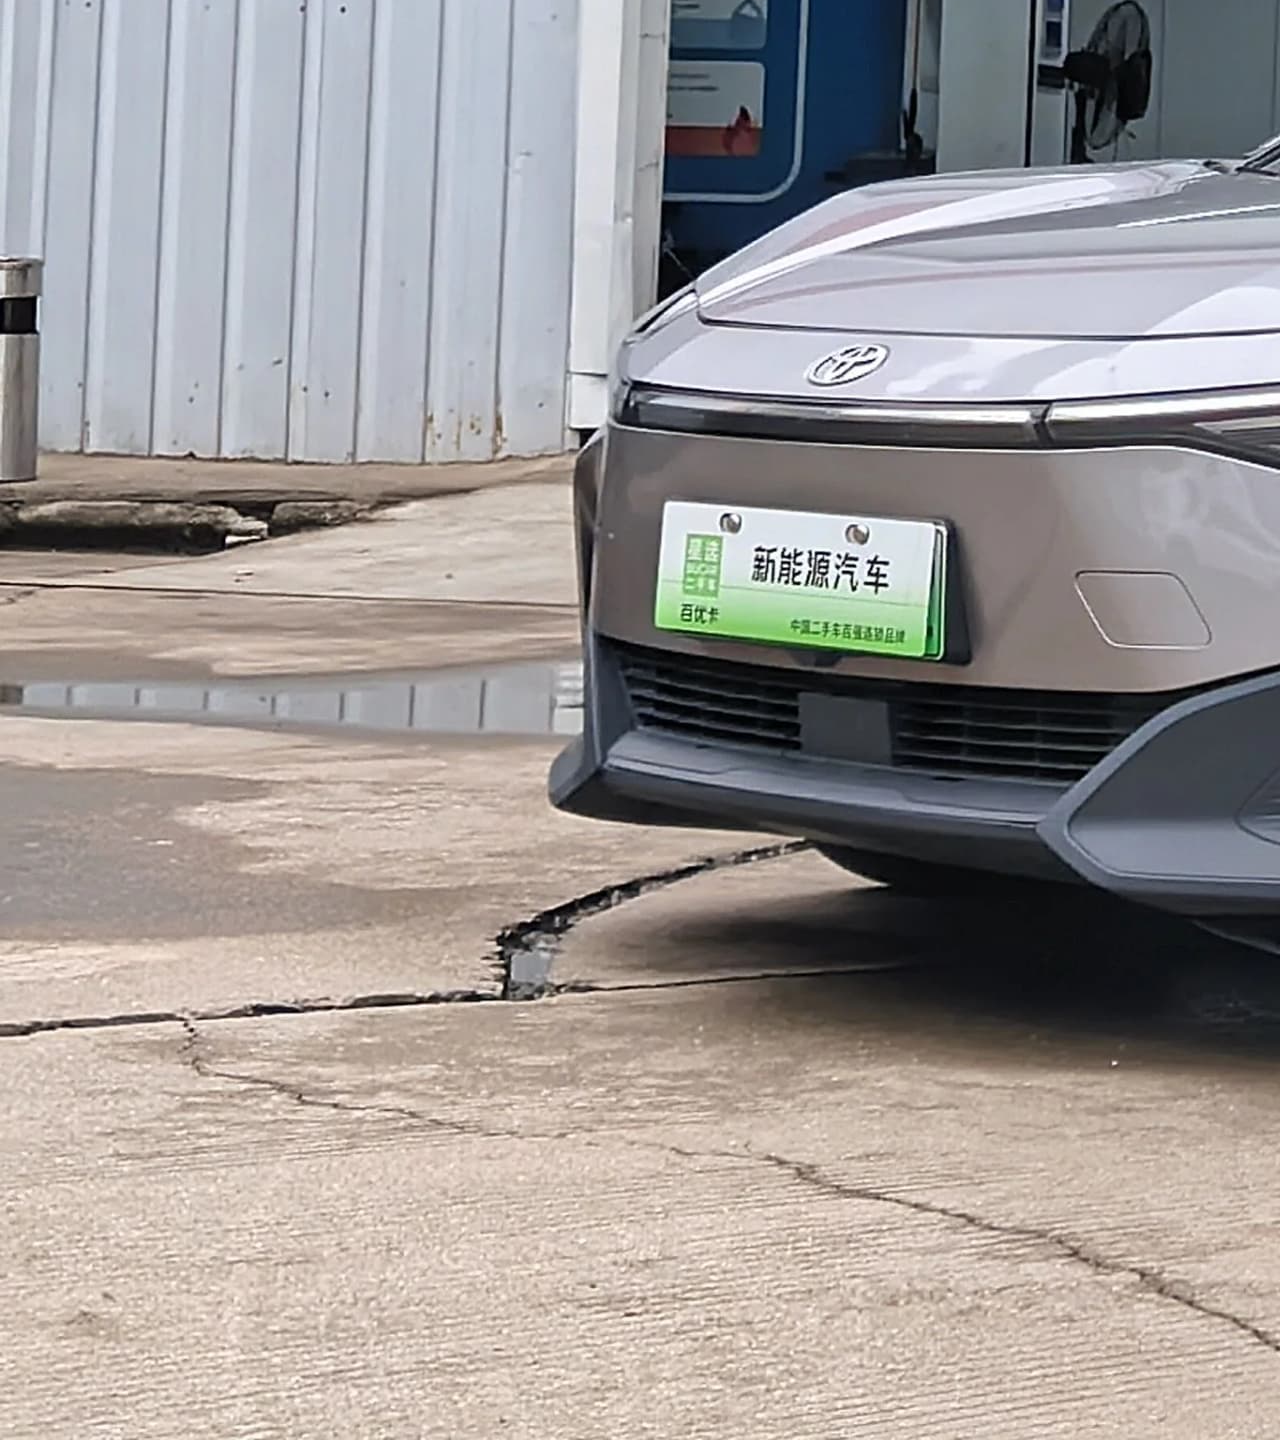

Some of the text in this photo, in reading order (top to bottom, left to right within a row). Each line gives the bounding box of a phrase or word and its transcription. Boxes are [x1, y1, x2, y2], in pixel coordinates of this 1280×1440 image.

[751, 545, 891, 596] 新能源汽车
[679, 603, 721, 624] 百优卡
